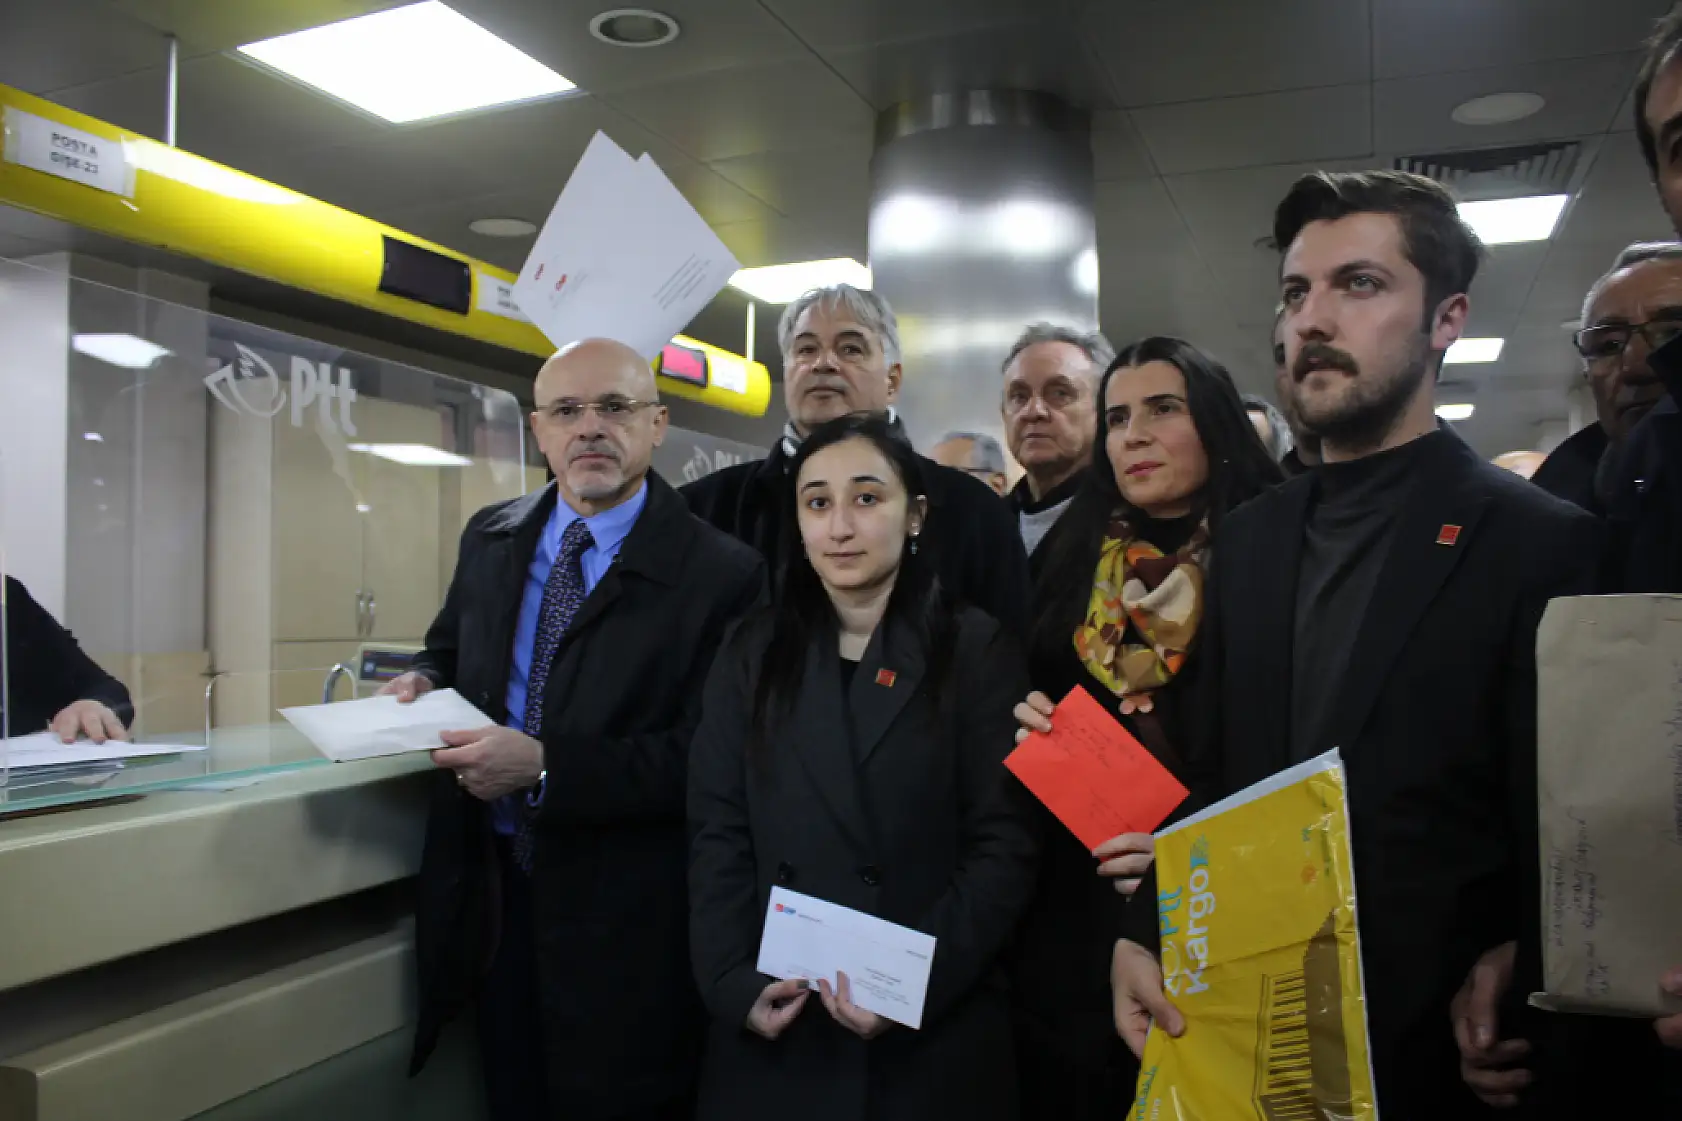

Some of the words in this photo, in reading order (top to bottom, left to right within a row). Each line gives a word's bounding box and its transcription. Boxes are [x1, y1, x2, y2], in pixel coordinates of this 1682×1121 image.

[52, 132, 98, 157] POSTA
[290, 355, 358, 437] Ptt
[1159, 886, 1183, 935] Ptt
[1186, 869, 1215, 994] Kargo
